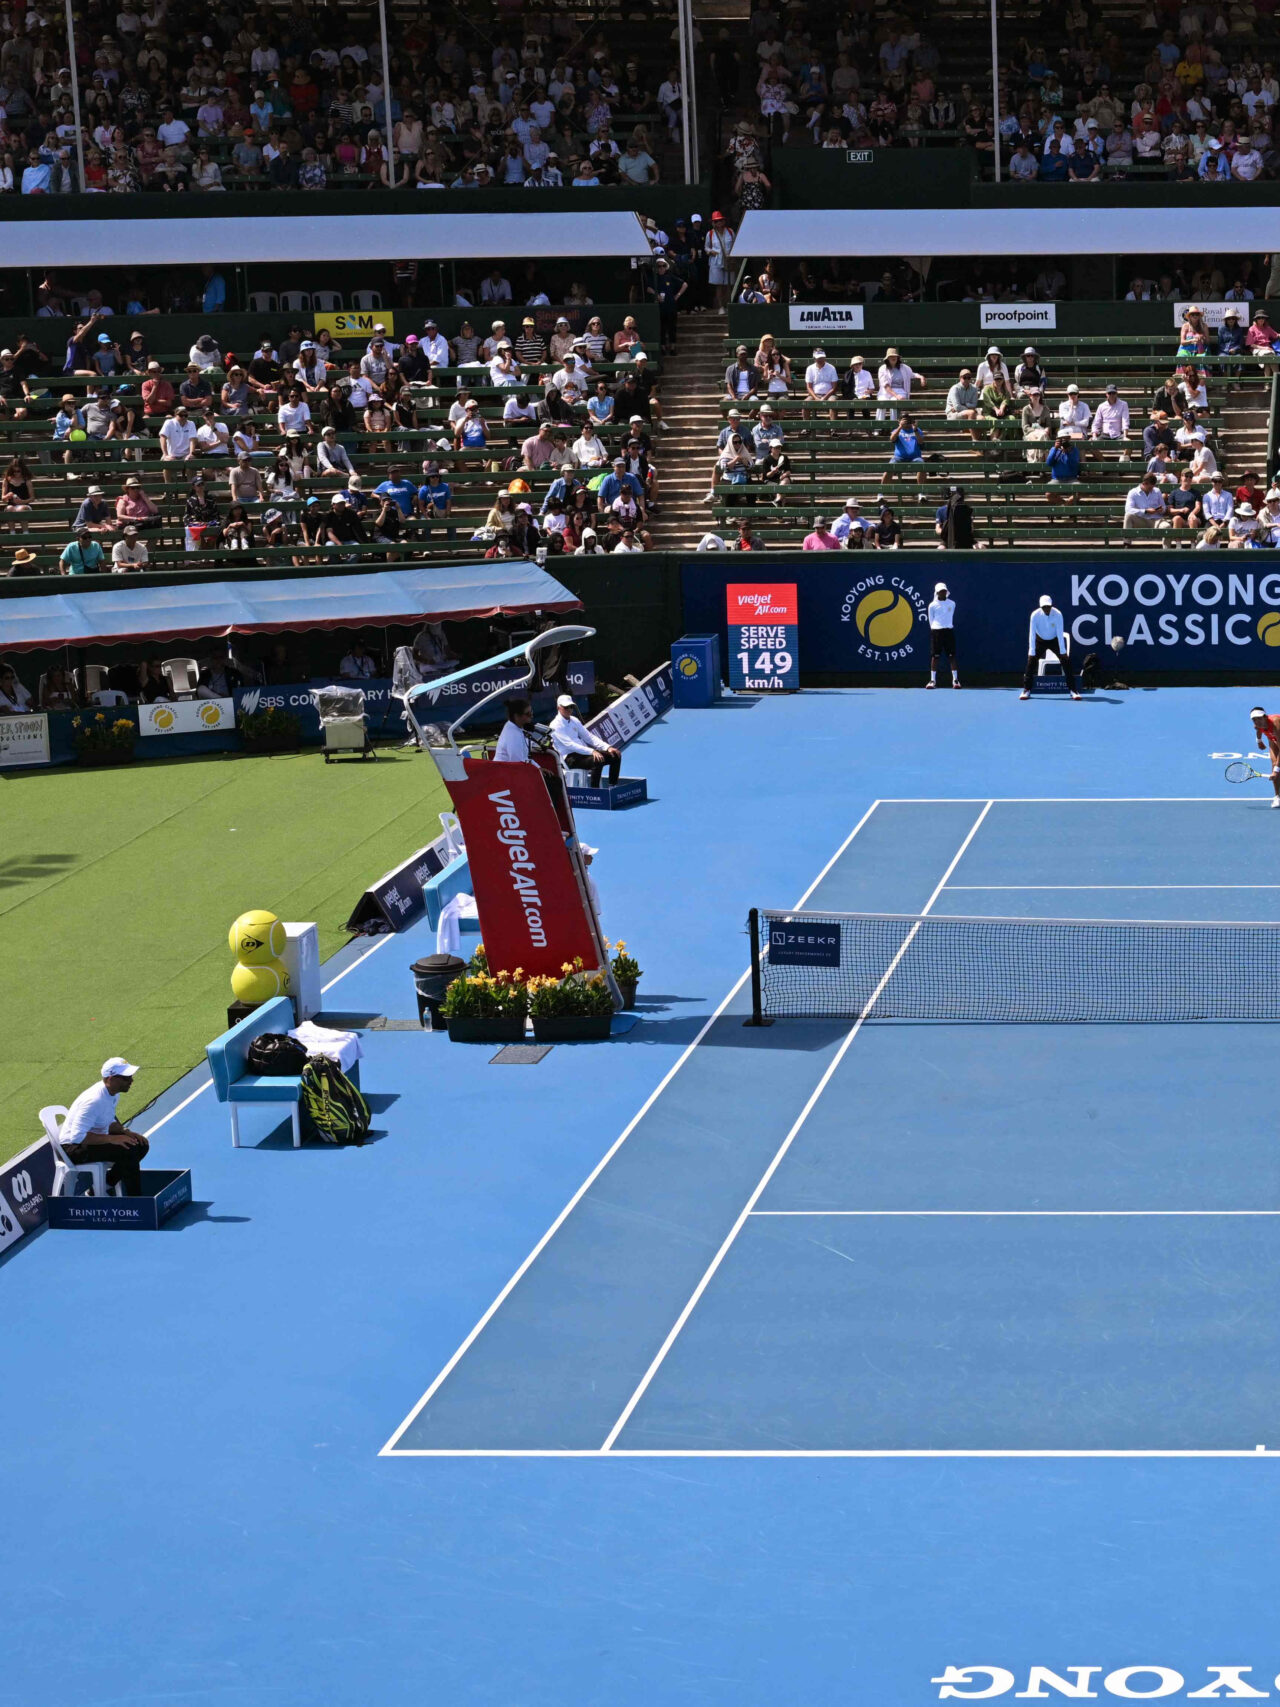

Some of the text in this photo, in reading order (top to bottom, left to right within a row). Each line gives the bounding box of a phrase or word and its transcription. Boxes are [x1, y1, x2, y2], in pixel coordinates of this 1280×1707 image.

[850, 151, 869, 161] EXIT
[800, 307, 853, 322] LAVAZZA
[1202, 308, 1222, 319] Royal
[841, 575, 928, 621] KOOYONG CLASSIC
[741, 627, 785, 637] SERVE
[1071, 613, 1253, 646] CLASSIC
[740, 638, 786, 649] SPEED
[736, 652, 792, 674] 149
[745, 676, 783, 688] km/h
[441, 683, 467, 696] SBS
[256, 696, 285, 708] SBS
[787, 935, 837, 945] ZEEKR
[68, 1208, 139, 1216] TRINITY YORK
